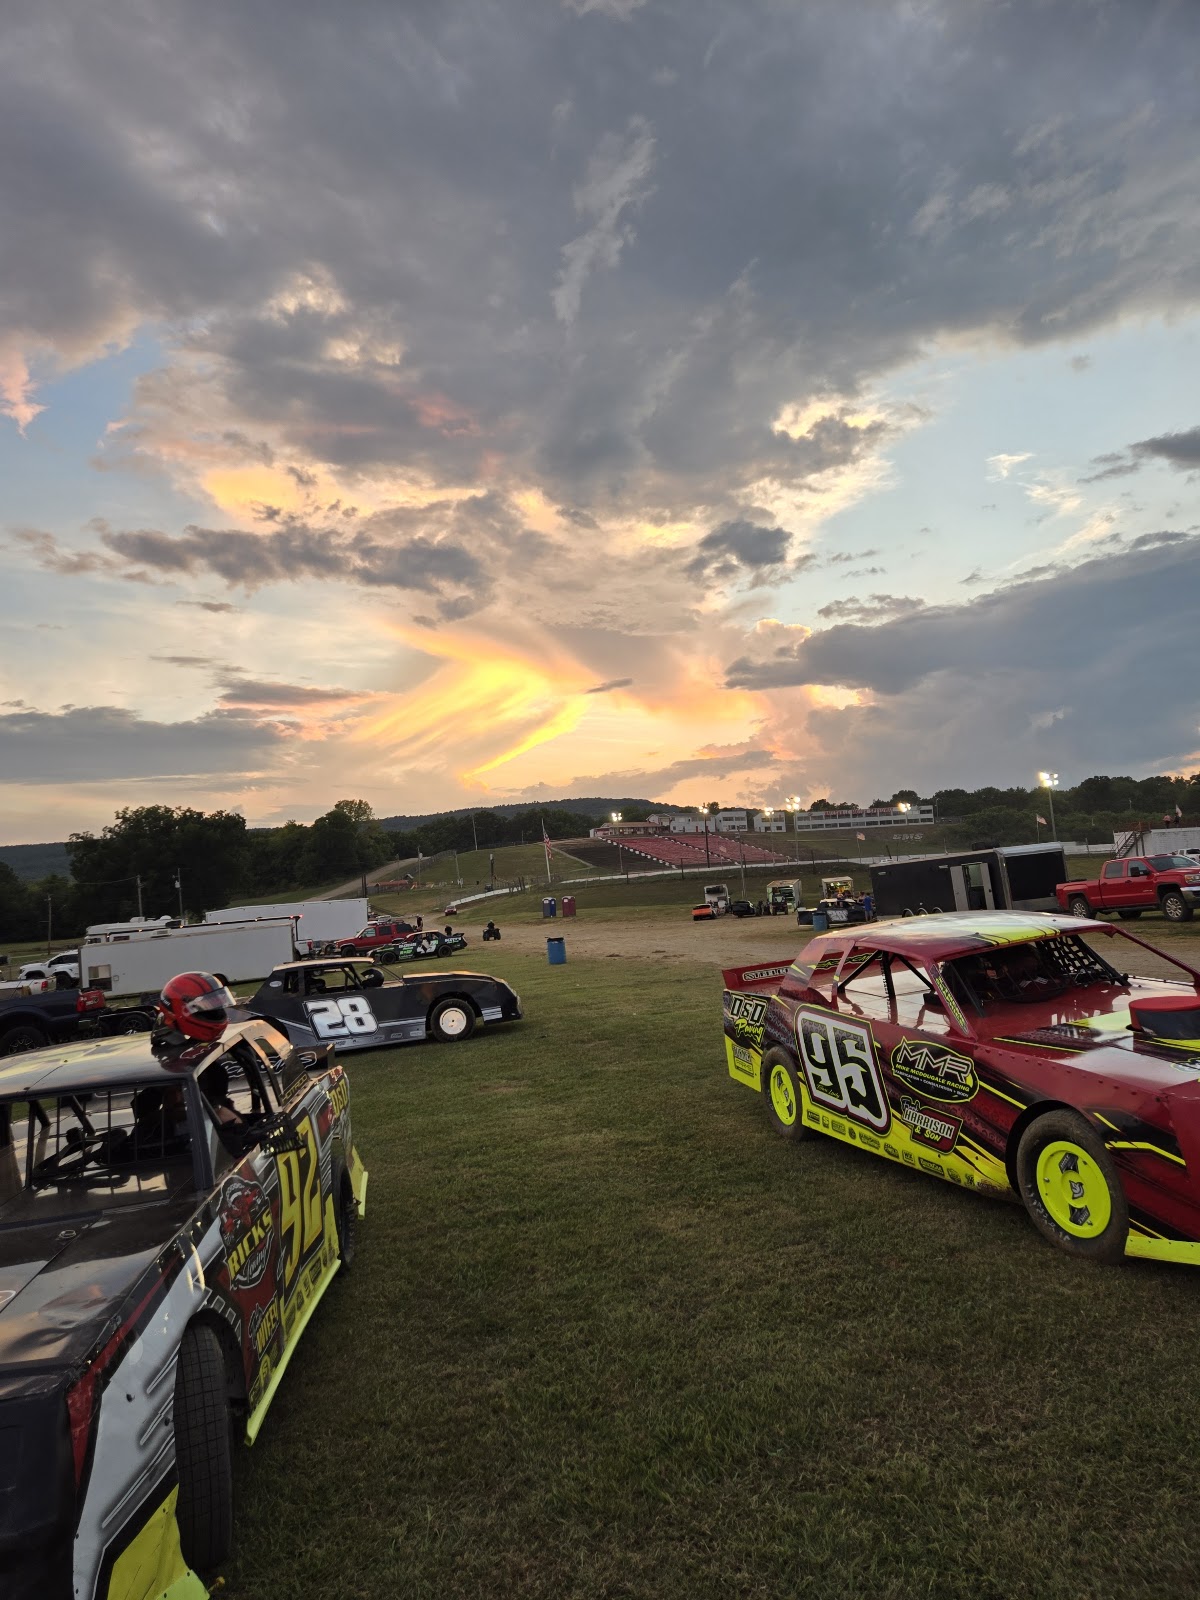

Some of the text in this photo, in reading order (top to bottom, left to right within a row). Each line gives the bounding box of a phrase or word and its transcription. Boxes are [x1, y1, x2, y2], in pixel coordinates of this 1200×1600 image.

[305, 996, 379, 1040] 28
[735, 1018, 764, 1043] Paving
[898, 1042, 972, 1083] MMR
[946, 1079, 970, 1092] RACING
[903, 1108, 955, 1140] HARRISON
[914, 1126, 942, 1143] & SON
[227, 1207, 272, 1280] RICKS
